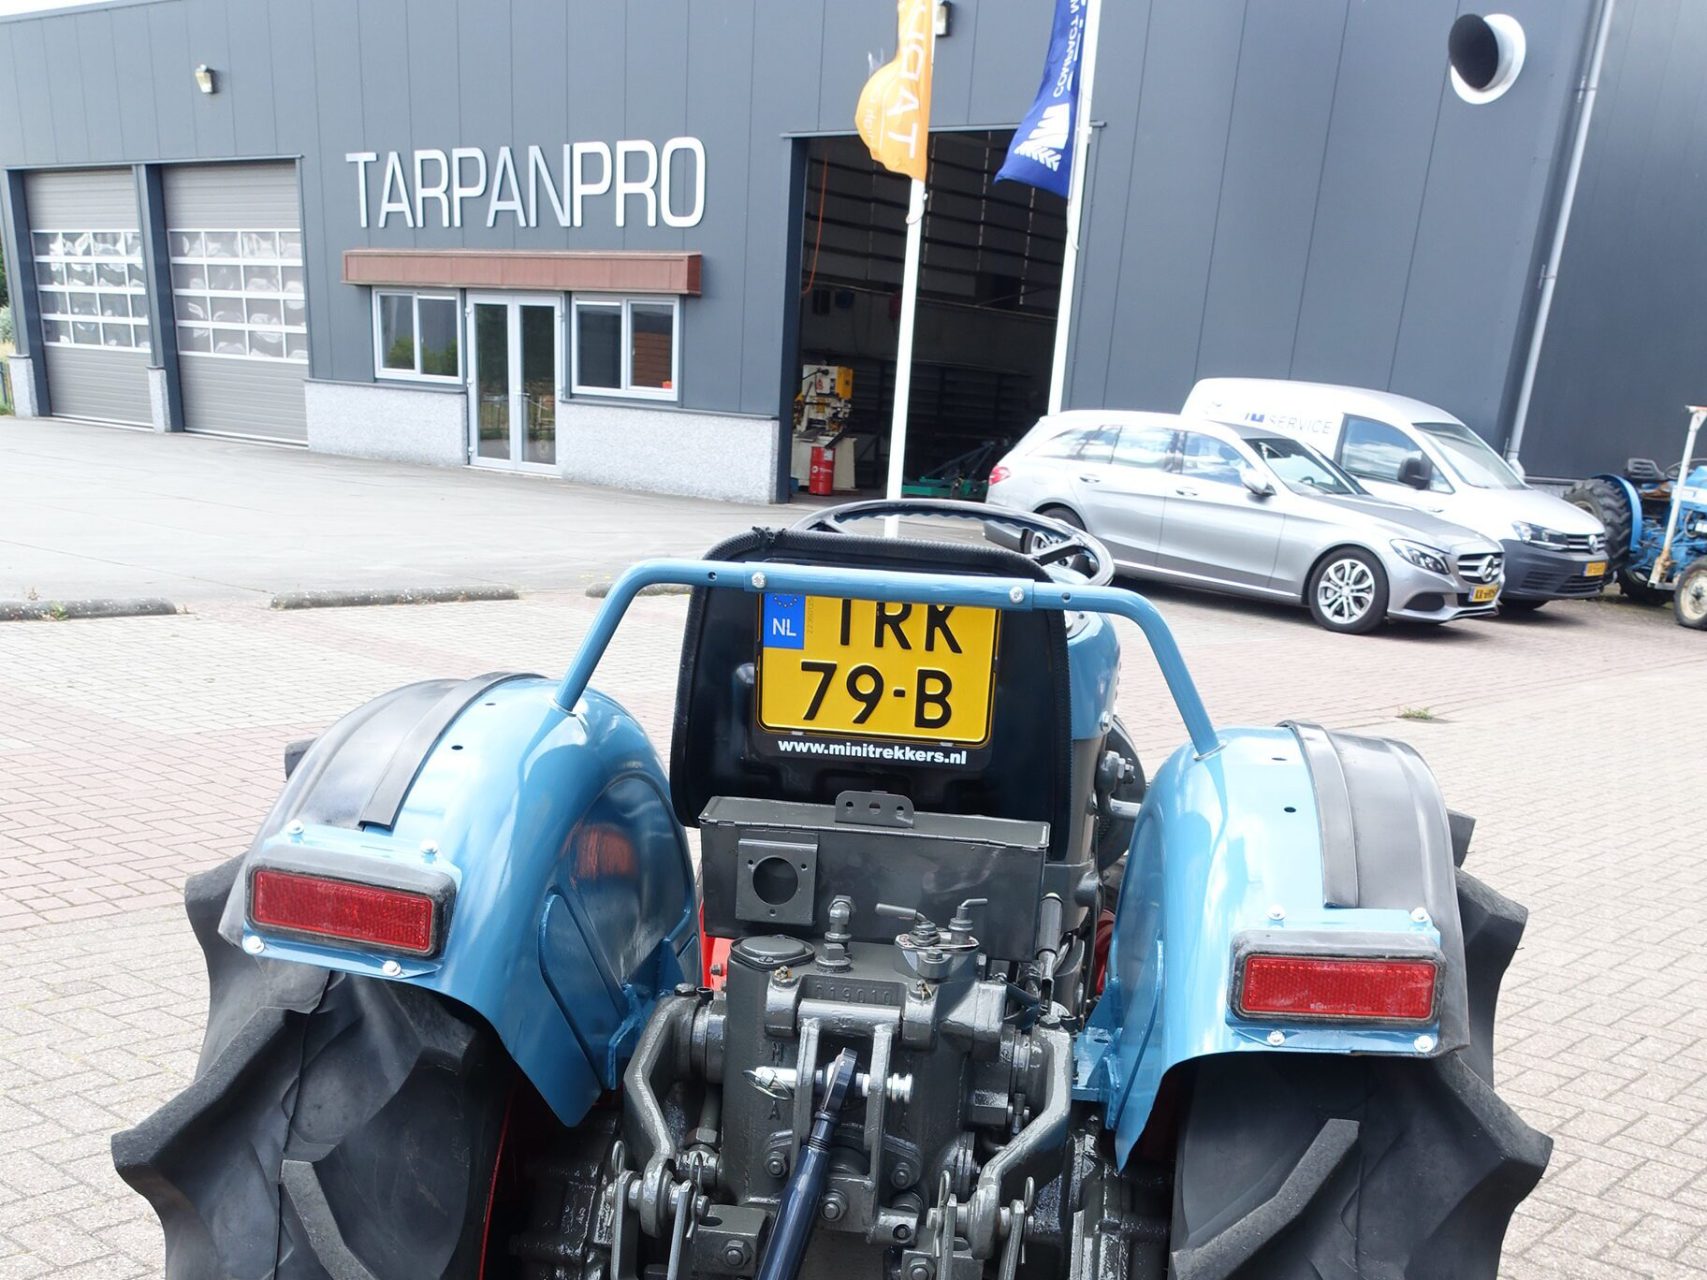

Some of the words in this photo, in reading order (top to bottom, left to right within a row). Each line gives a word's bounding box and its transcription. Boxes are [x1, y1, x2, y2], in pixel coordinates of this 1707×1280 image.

[345, 136, 706, 228] TARPANPRO
[772, 617, 797, 637] NL
[800, 660, 953, 729] 79-B
[778, 739, 967, 765] www.minitrekkers.nl
